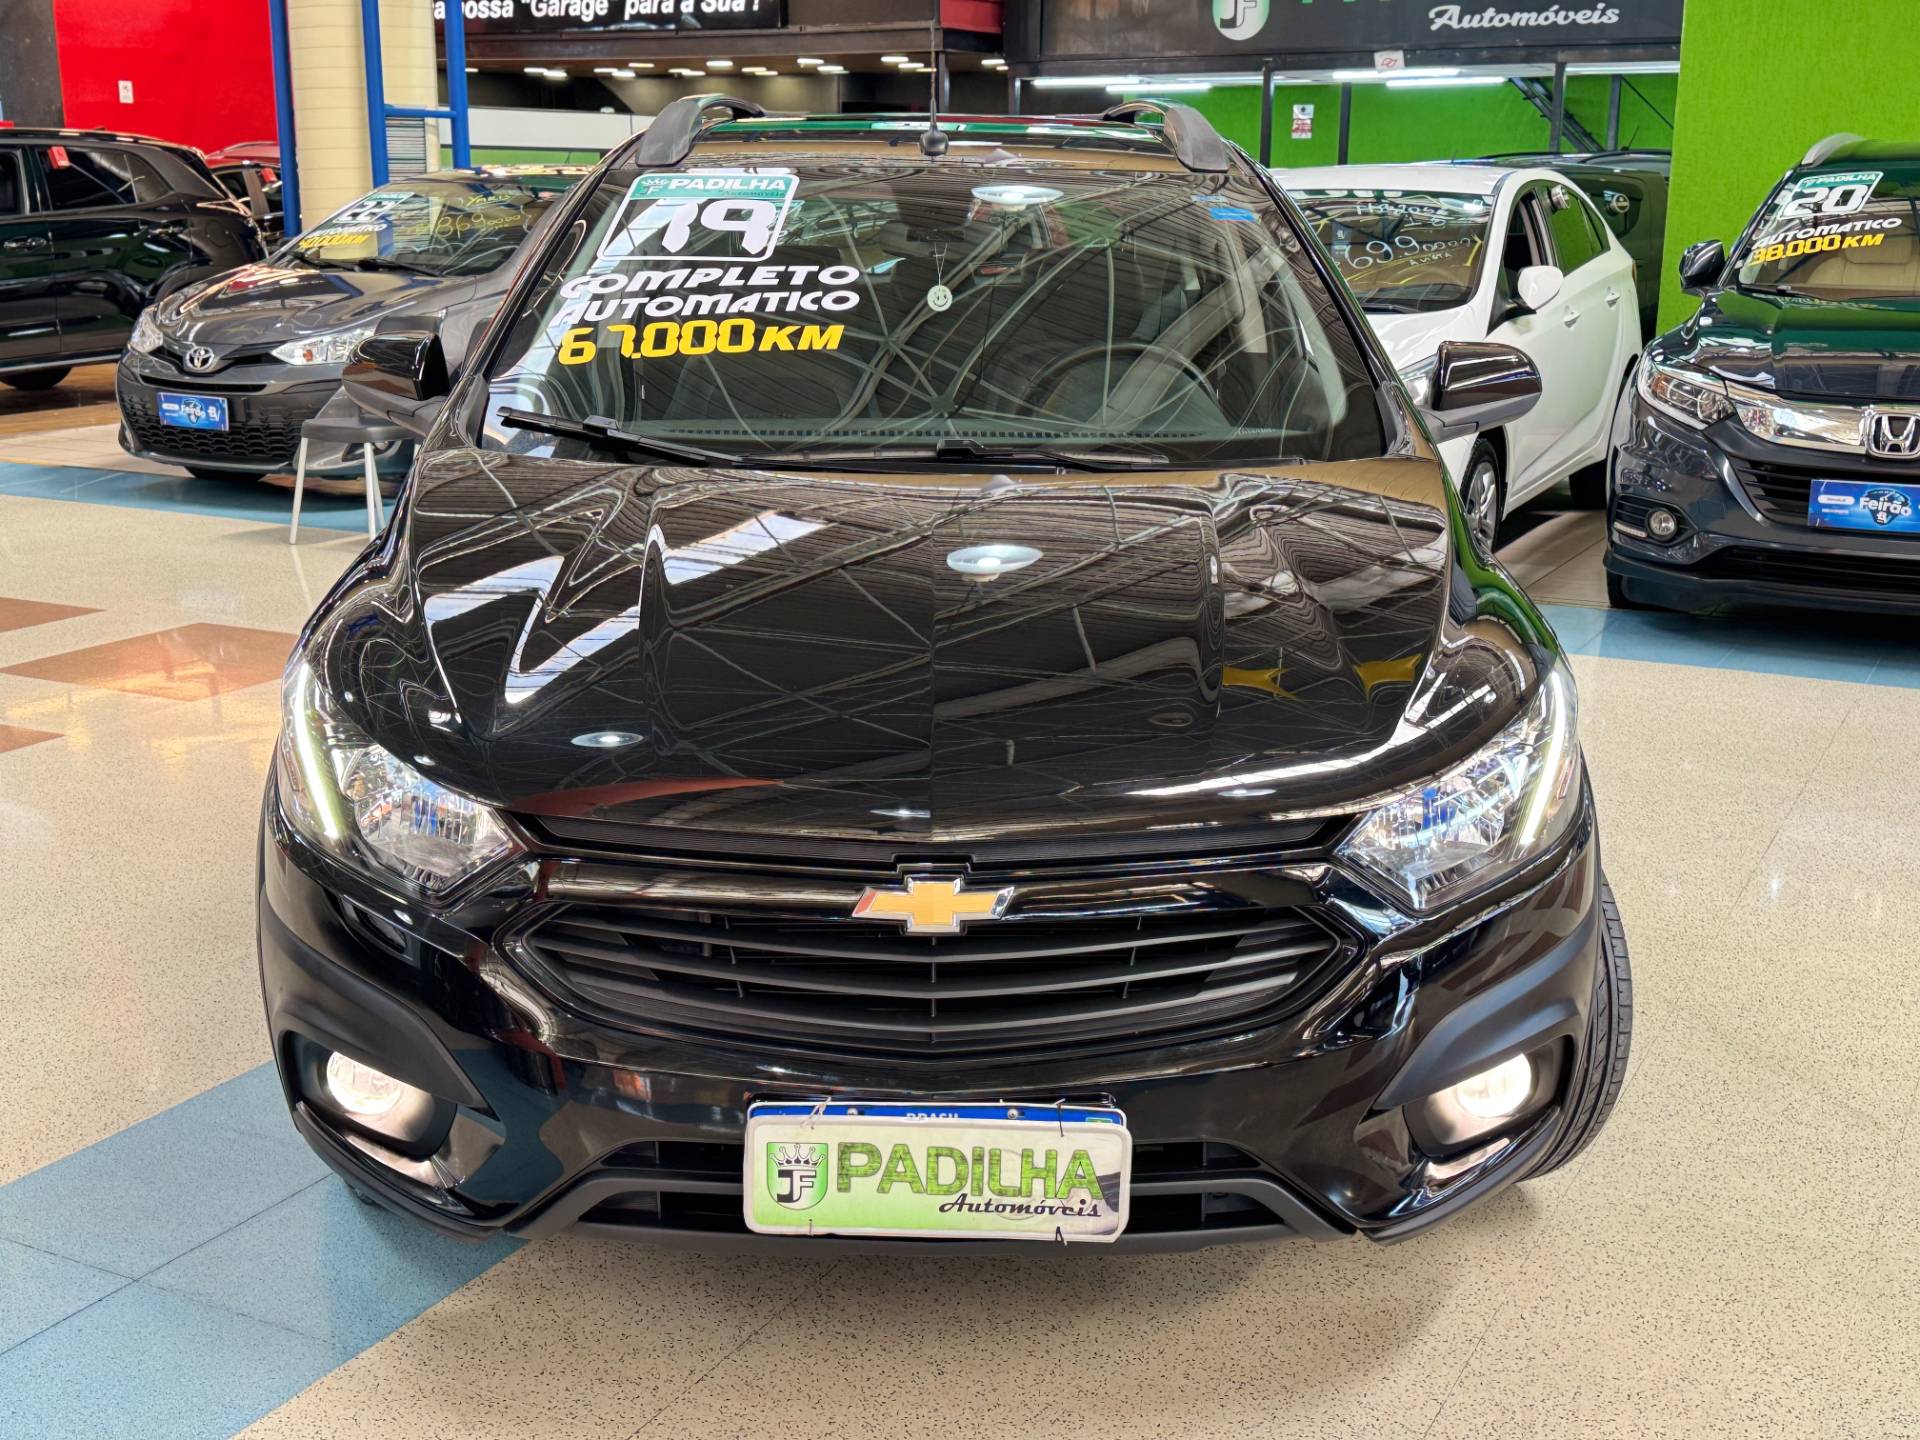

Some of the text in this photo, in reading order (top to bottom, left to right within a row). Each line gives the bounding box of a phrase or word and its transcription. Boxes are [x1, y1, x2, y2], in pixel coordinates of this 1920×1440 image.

[461, 0, 513, 19] ossa
[624, 0, 674, 20] para
[1428, 2, 1620, 31] Automóveis
[667, 178, 786, 190] PADILHA
[1783, 184, 1868, 217] 20
[1751, 217, 1903, 249] AUTOMATICO
[559, 265, 861, 299] COMPLETO
[549, 290, 861, 327] AUTOMATICO
[1860, 496, 1912, 517] Feirão
[836, 1141, 1104, 1200] PADILHA
[938, 1192, 1102, 1218] Automóveis
